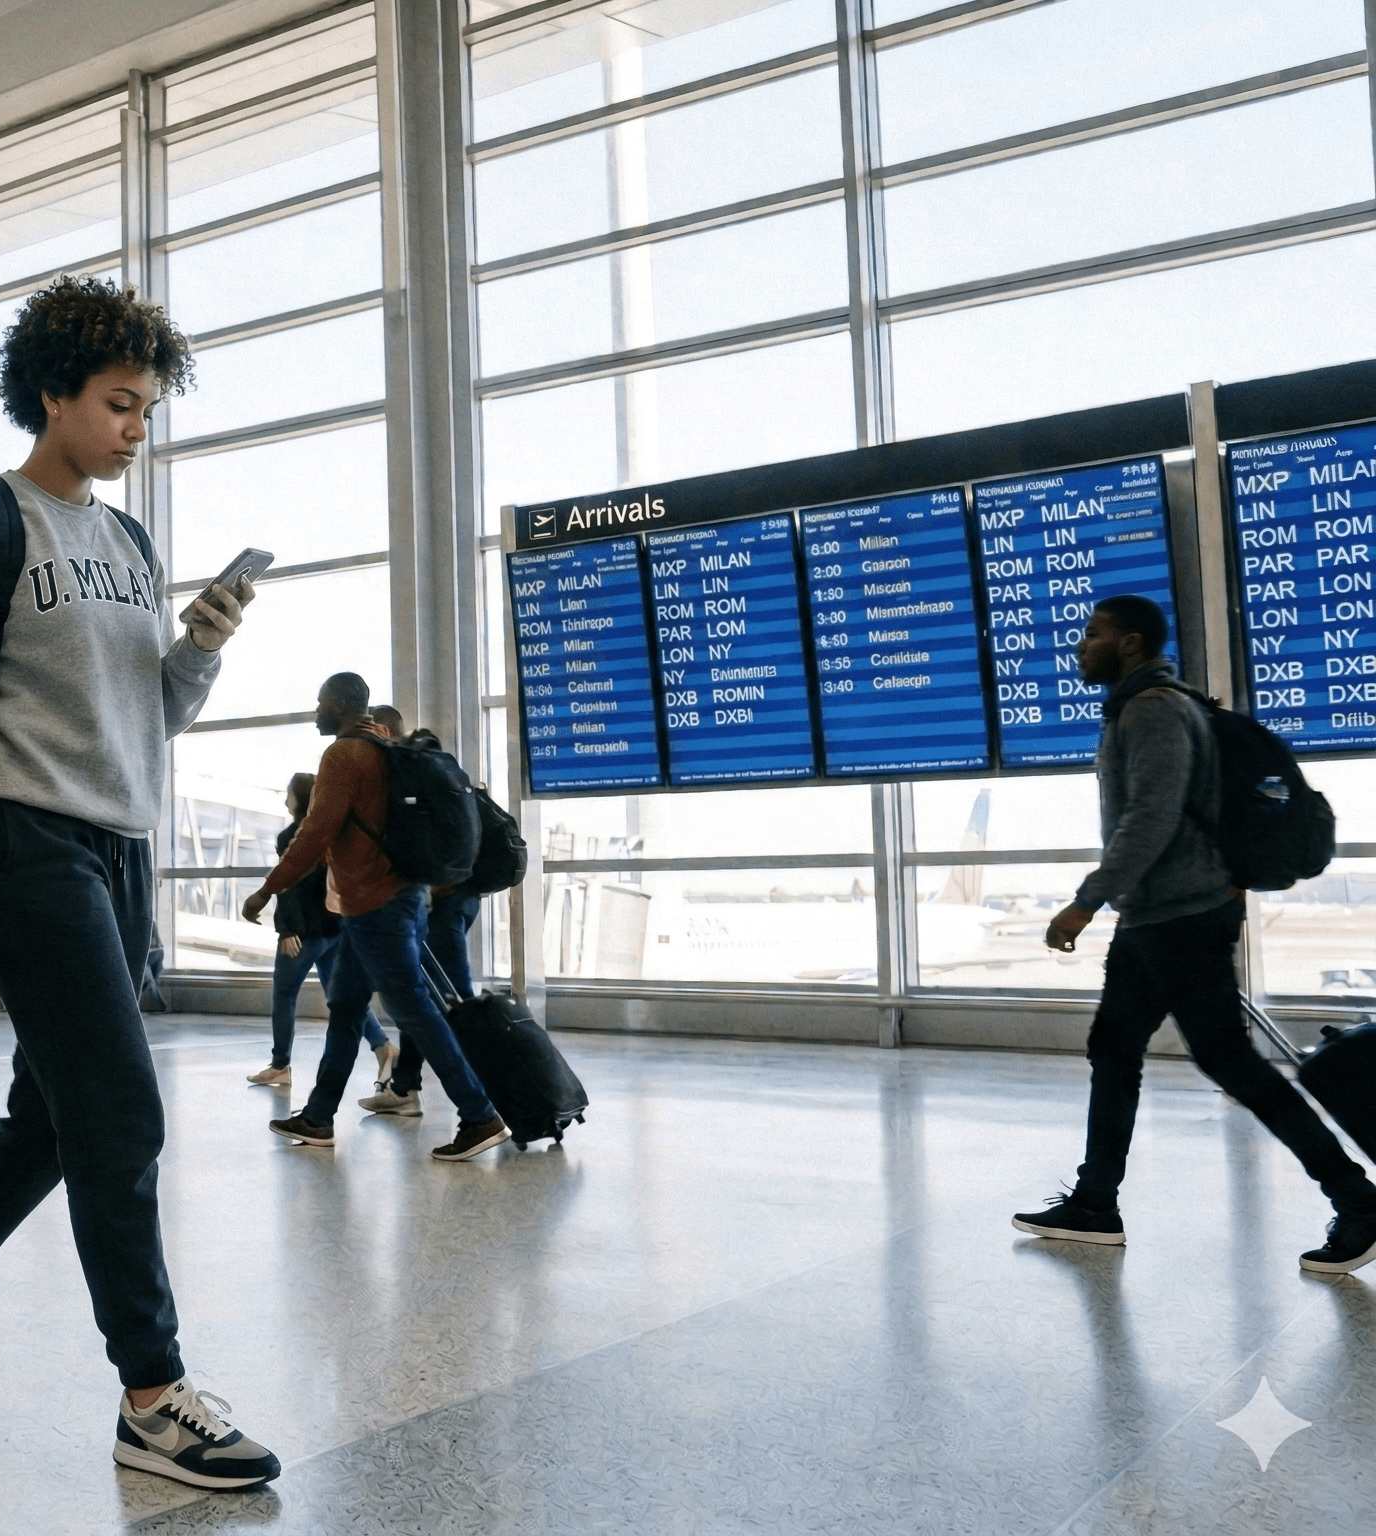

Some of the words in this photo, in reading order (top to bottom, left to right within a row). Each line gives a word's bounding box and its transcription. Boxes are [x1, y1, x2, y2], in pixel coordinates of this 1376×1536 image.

[1236, 471, 1290, 496] MXP
[566, 493, 666, 532] Arrivals
[980, 508, 1024, 531] MXP
[1041, 497, 1105, 523] MILAN
[1239, 500, 1275, 523] LIN
[1312, 490, 1351, 513] LIN
[982, 535, 1014, 555] LIN
[1044, 527, 1077, 548] LIN
[1242, 524, 1297, 550] ROM
[1315, 514, 1373, 540] ROM
[652, 560, 686, 578] MXP
[700, 551, 751, 572] MILAN
[813, 564, 842, 579] 2:00
[986, 557, 1034, 580] ROM
[1046, 550, 1096, 573] ROM
[1244, 552, 1295, 576] PAR
[1317, 544, 1370, 568] PAR
[28, 558, 71, 614] U.
[515, 580, 546, 597] MXP
[558, 573, 602, 591] MILAN
[655, 582, 679, 599] LIN
[702, 576, 728, 594] LIN
[988, 583, 1032, 604] PAR
[1049, 576, 1093, 598] PAR
[1246, 580, 1297, 603] PAR
[1319, 572, 1372, 595] LON
[517, 602, 540, 618] LIN
[657, 602, 694, 621] ROM
[704, 596, 746, 616] ROM
[991, 608, 1033, 628] PAR
[1051, 601, 1095, 623] LON
[1249, 607, 1298, 629] LON
[1322, 599, 1374, 622] LON
[520, 621, 552, 637] ROM
[659, 625, 692, 642] PAR
[707, 619, 746, 638] LOM
[521, 643, 549, 657] MXP
[564, 639, 594, 652] Milan
[662, 647, 694, 664] LON
[709, 643, 732, 660] NY
[994, 632, 1035, 652] LON
[1252, 635, 1286, 656] NY
[1324, 628, 1360, 650] NY
[565, 660, 596, 673] Milan
[664, 669, 685, 686] NY
[996, 658, 1023, 676] NY
[1254, 661, 1304, 683] DXB
[1326, 655, 1376, 677] DXB
[665, 690, 698, 707] DXB
[713, 685, 765, 703] ROMIN
[998, 682, 1039, 701] DXB
[1256, 688, 1306, 709] DXB
[668, 711, 700, 728] DXB
[1001, 706, 1042, 724] DXB
